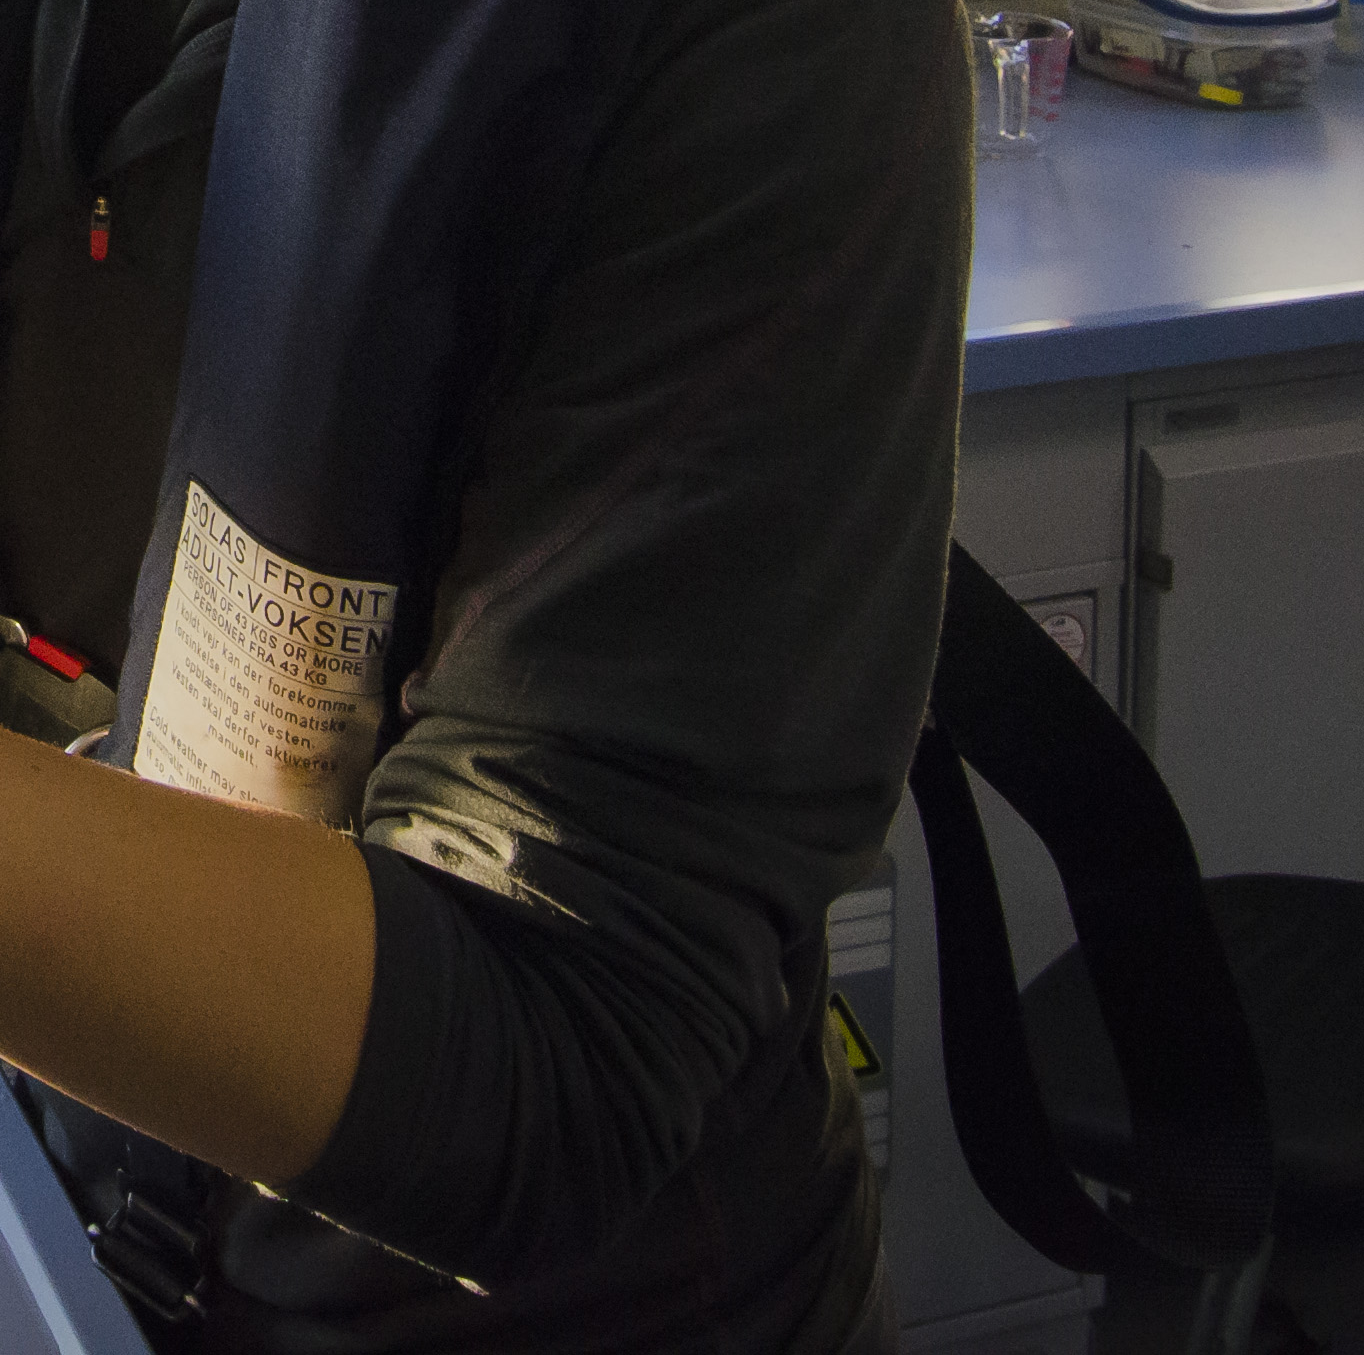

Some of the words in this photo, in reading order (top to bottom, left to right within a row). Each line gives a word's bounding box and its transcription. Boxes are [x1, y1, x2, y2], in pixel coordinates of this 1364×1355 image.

[192, 492, 246, 564] SOLAS
[263, 558, 388, 618] FRONT
[180, 602, 200, 633] koldt
[202, 627, 220, 650] vejr
[221, 640, 241, 669] kan
[243, 662, 264, 684] der
[268, 676, 358, 714] forekomme
[184, 560, 217, 603] PERSON
[219, 596, 234, 614] OF
[235, 612, 247, 630] 43
[250, 622, 278, 650] KGS
[283, 642, 307, 664] OR
[312, 652, 364, 677] MORE
[194, 590, 246, 647] PERSONER
[249, 641, 275, 667] FRA
[279, 659, 300, 677] 43
[304, 668, 328, 686] KG
[172, 661, 199, 700] Vesten
[201, 695, 222, 721] skal
[224, 715, 260, 749] derfor
[174, 620, 220, 674] forsinkelse
[229, 674, 250, 699] den
[253, 694, 347, 733] automatiske
[185, 656, 239, 716] opblæsning
[243, 709, 256, 724] af
[149, 705, 169, 737] Cold
[170, 730, 208, 774] weather
[210, 768, 237, 796] may
